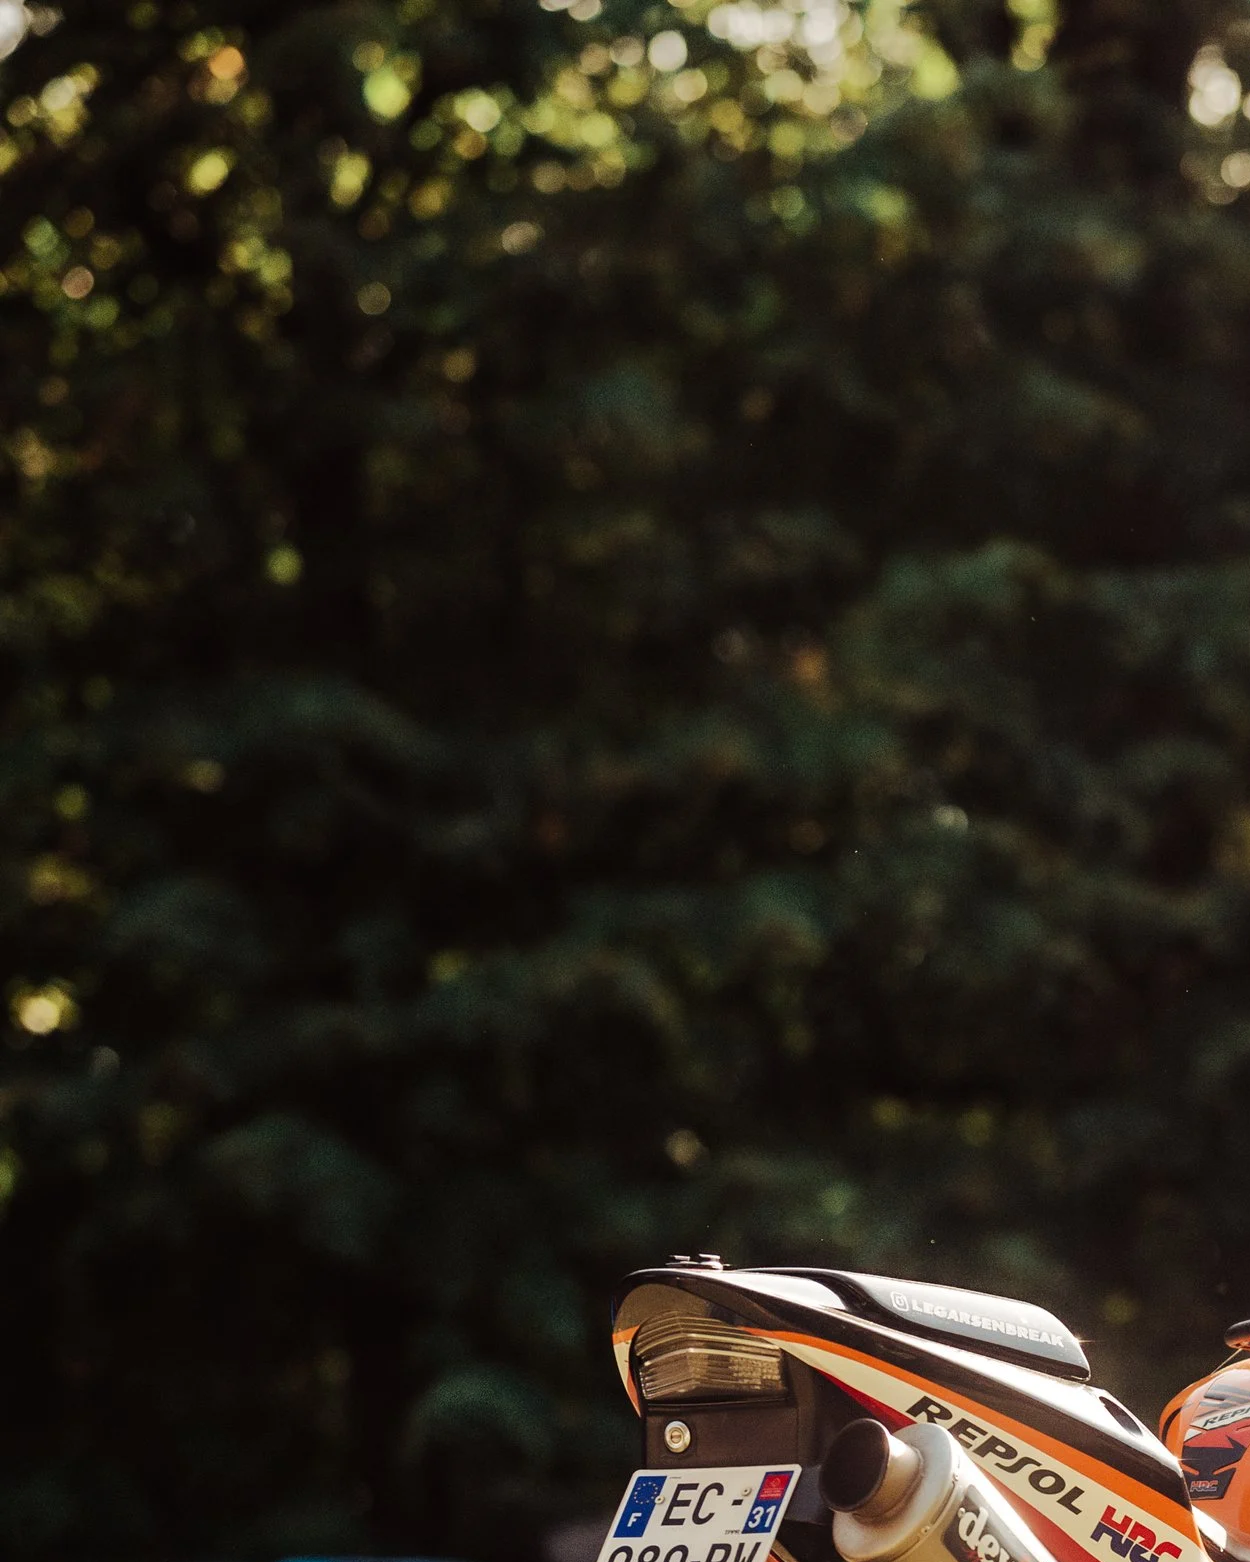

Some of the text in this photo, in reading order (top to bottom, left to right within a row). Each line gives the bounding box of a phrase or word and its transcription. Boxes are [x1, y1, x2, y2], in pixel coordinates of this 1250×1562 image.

[911, 1299, 1064, 1348] LEGARSENBREAK
[905, 1395, 1086, 1516] REPSOL
[1189, 1480, 1219, 1493] HRC
[627, 1512, 642, 1527] F
[748, 1505, 777, 1529] 31
